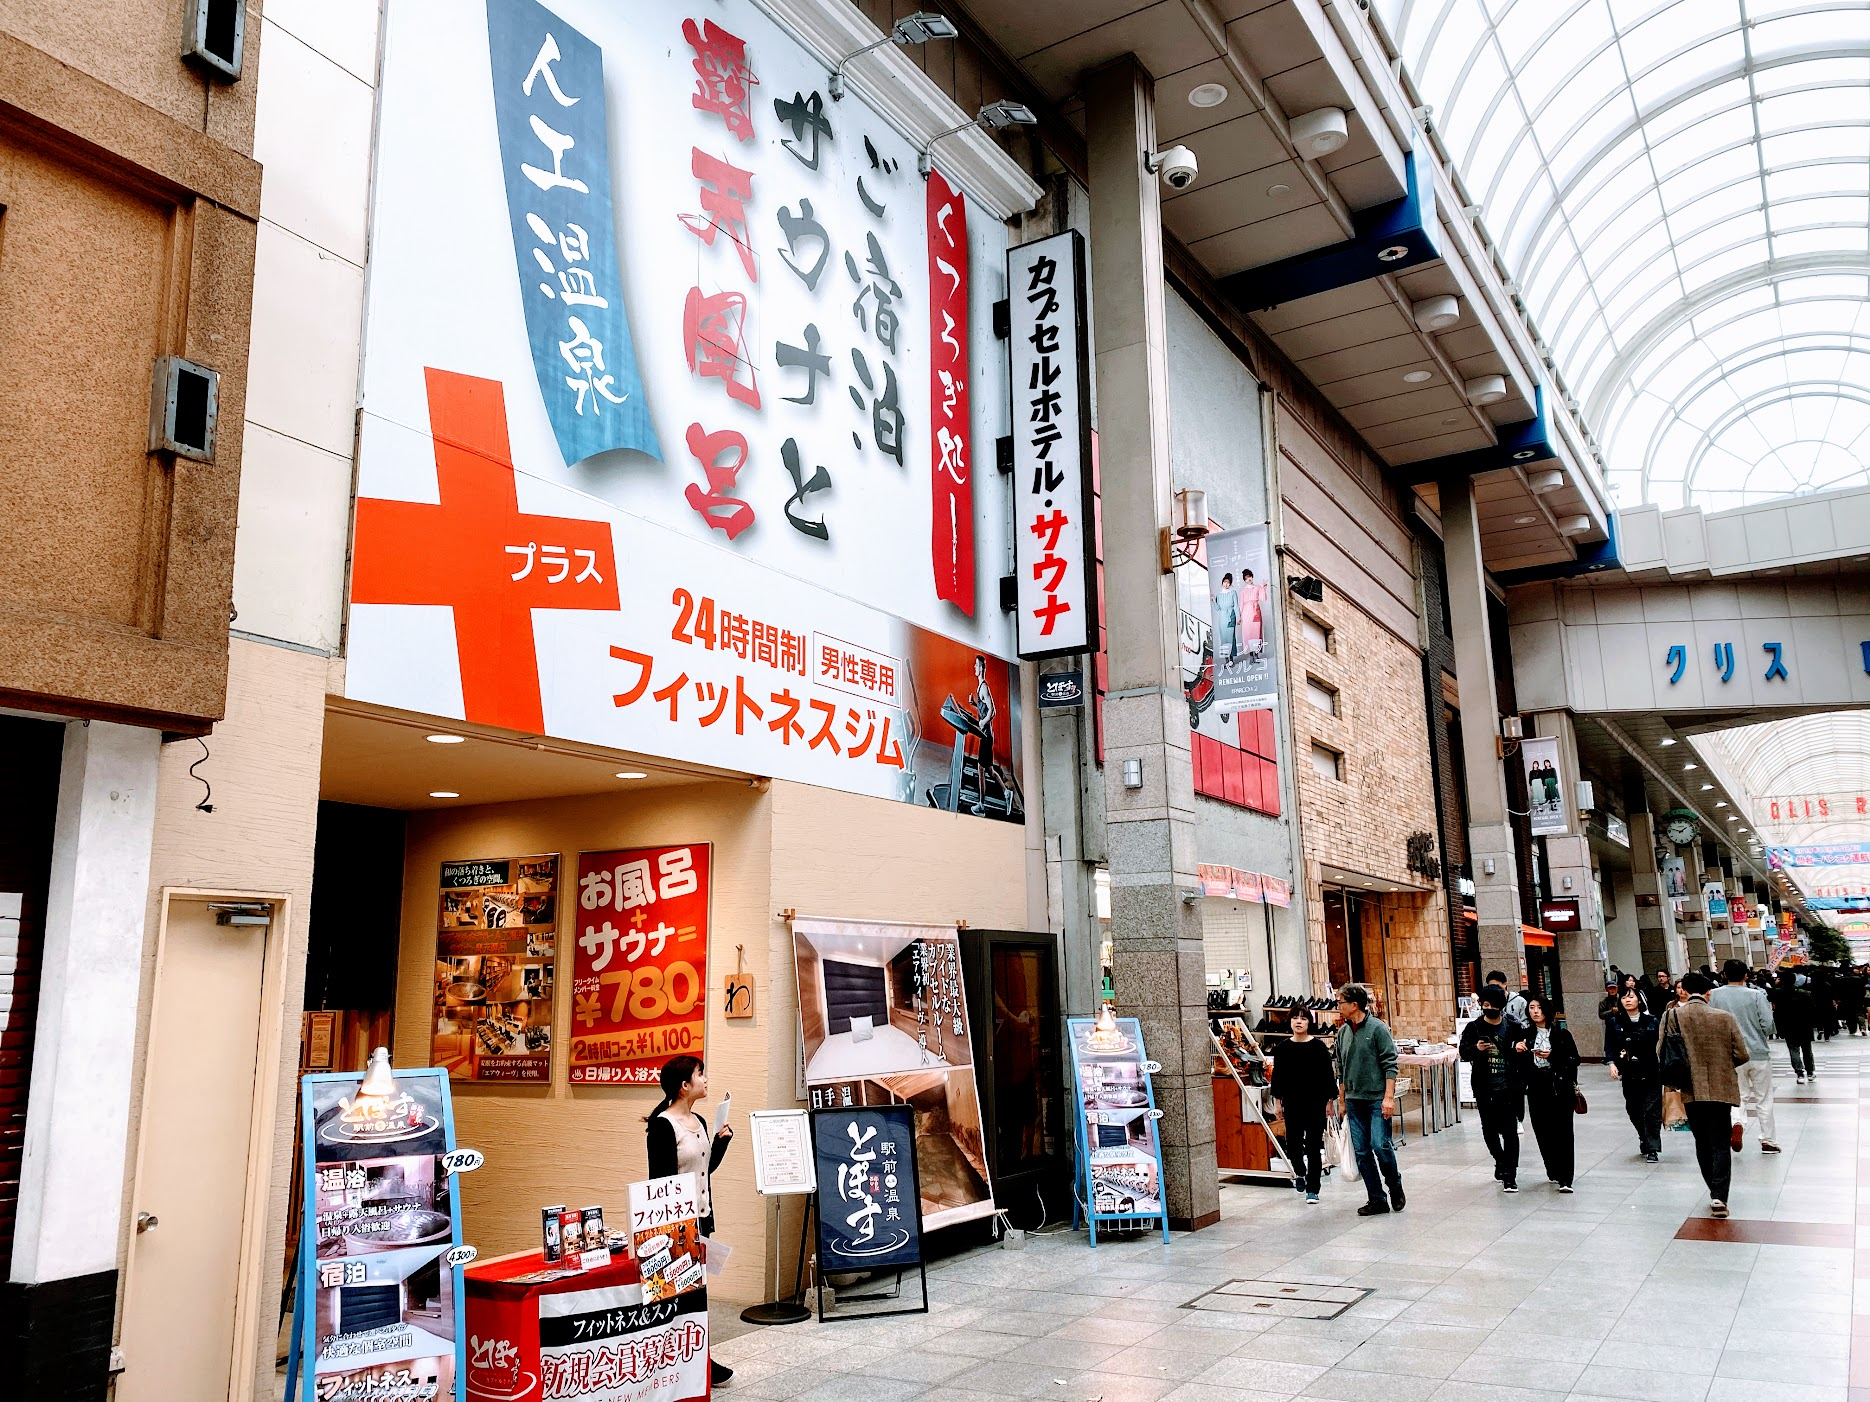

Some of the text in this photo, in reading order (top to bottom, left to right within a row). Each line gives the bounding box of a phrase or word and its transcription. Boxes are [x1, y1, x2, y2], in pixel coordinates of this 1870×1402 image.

[521, 33, 629, 418] 人工温泉
[678, 17, 761, 541] 露天風呂
[847, 135, 906, 468] ご宿泊
[774, 90, 834, 541] サウナと
[1027, 255, 1071, 636] カプセルホテル・サウナ
[504, 543, 603, 584] プラス
[671, 587, 806, 678] 24時間制
[820, 645, 895, 698] 男性専用
[1219, 676, 1245, 686] RENEWAL
[1247, 674, 1262, 682] OPEN
[1666, 642, 1789, 684] クリス
[609, 645, 905, 771] フィットネスジム
[579, 848, 698, 912] お風呂
[575, 977, 599, 986] フリータイム
[920, 943, 930, 986] 業界初
[937, 943, 951, 1014] ワイドな
[725, 981, 750, 1013] わ
[928, 943, 947, 1061] カプセルルーム
[946, 943, 963, 1036] 業界最大級
[322, 1168, 366, 1192] 温浴
[646, 1179, 682, 1202] Let's
[837, 1121, 882, 1246] とぽす
[1092, 1167, 1136, 1178] フィットネス
[634, 1200, 696, 1227] フィットネス
[321, 1262, 366, 1288] 宿泊
[573, 1299, 679, 1339] フィットネス&スパ
[322, 1333, 412, 1360] 快適な個室空間
[541, 1321, 703, 1400] 新規会員募集中
[321, 1370, 411, 1400] フィットネス
